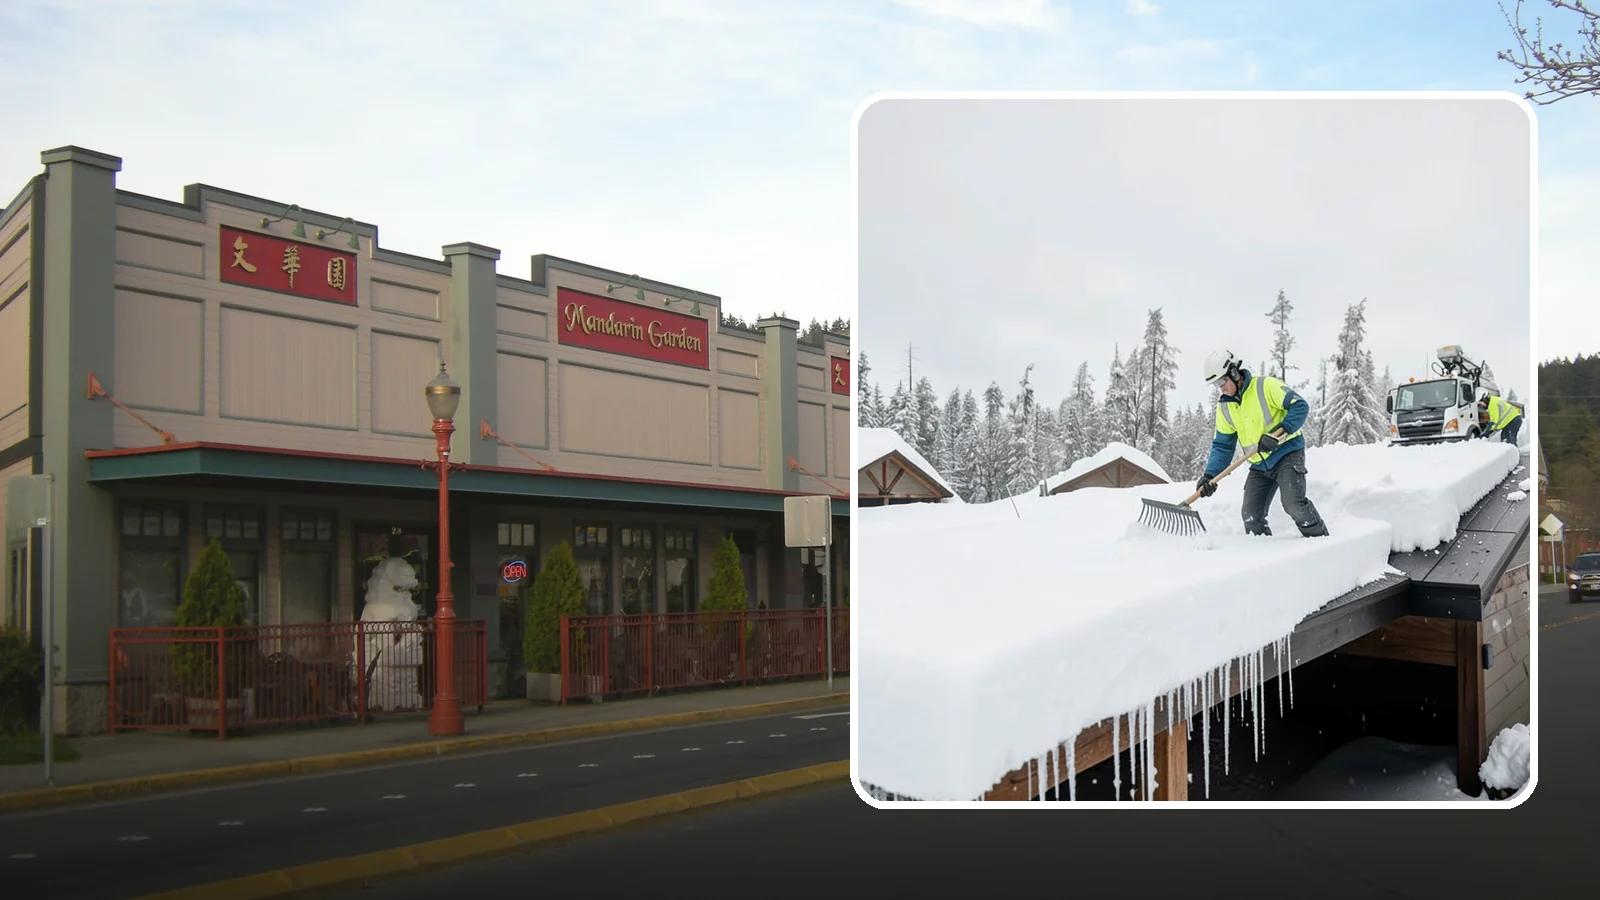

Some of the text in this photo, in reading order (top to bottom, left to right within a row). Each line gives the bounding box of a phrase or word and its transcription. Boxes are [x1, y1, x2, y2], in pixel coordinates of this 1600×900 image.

[230, 235, 347, 291] 文華園
[564, 302, 702, 352] Mandarin Garden
[503, 565, 527, 578] OPEN
